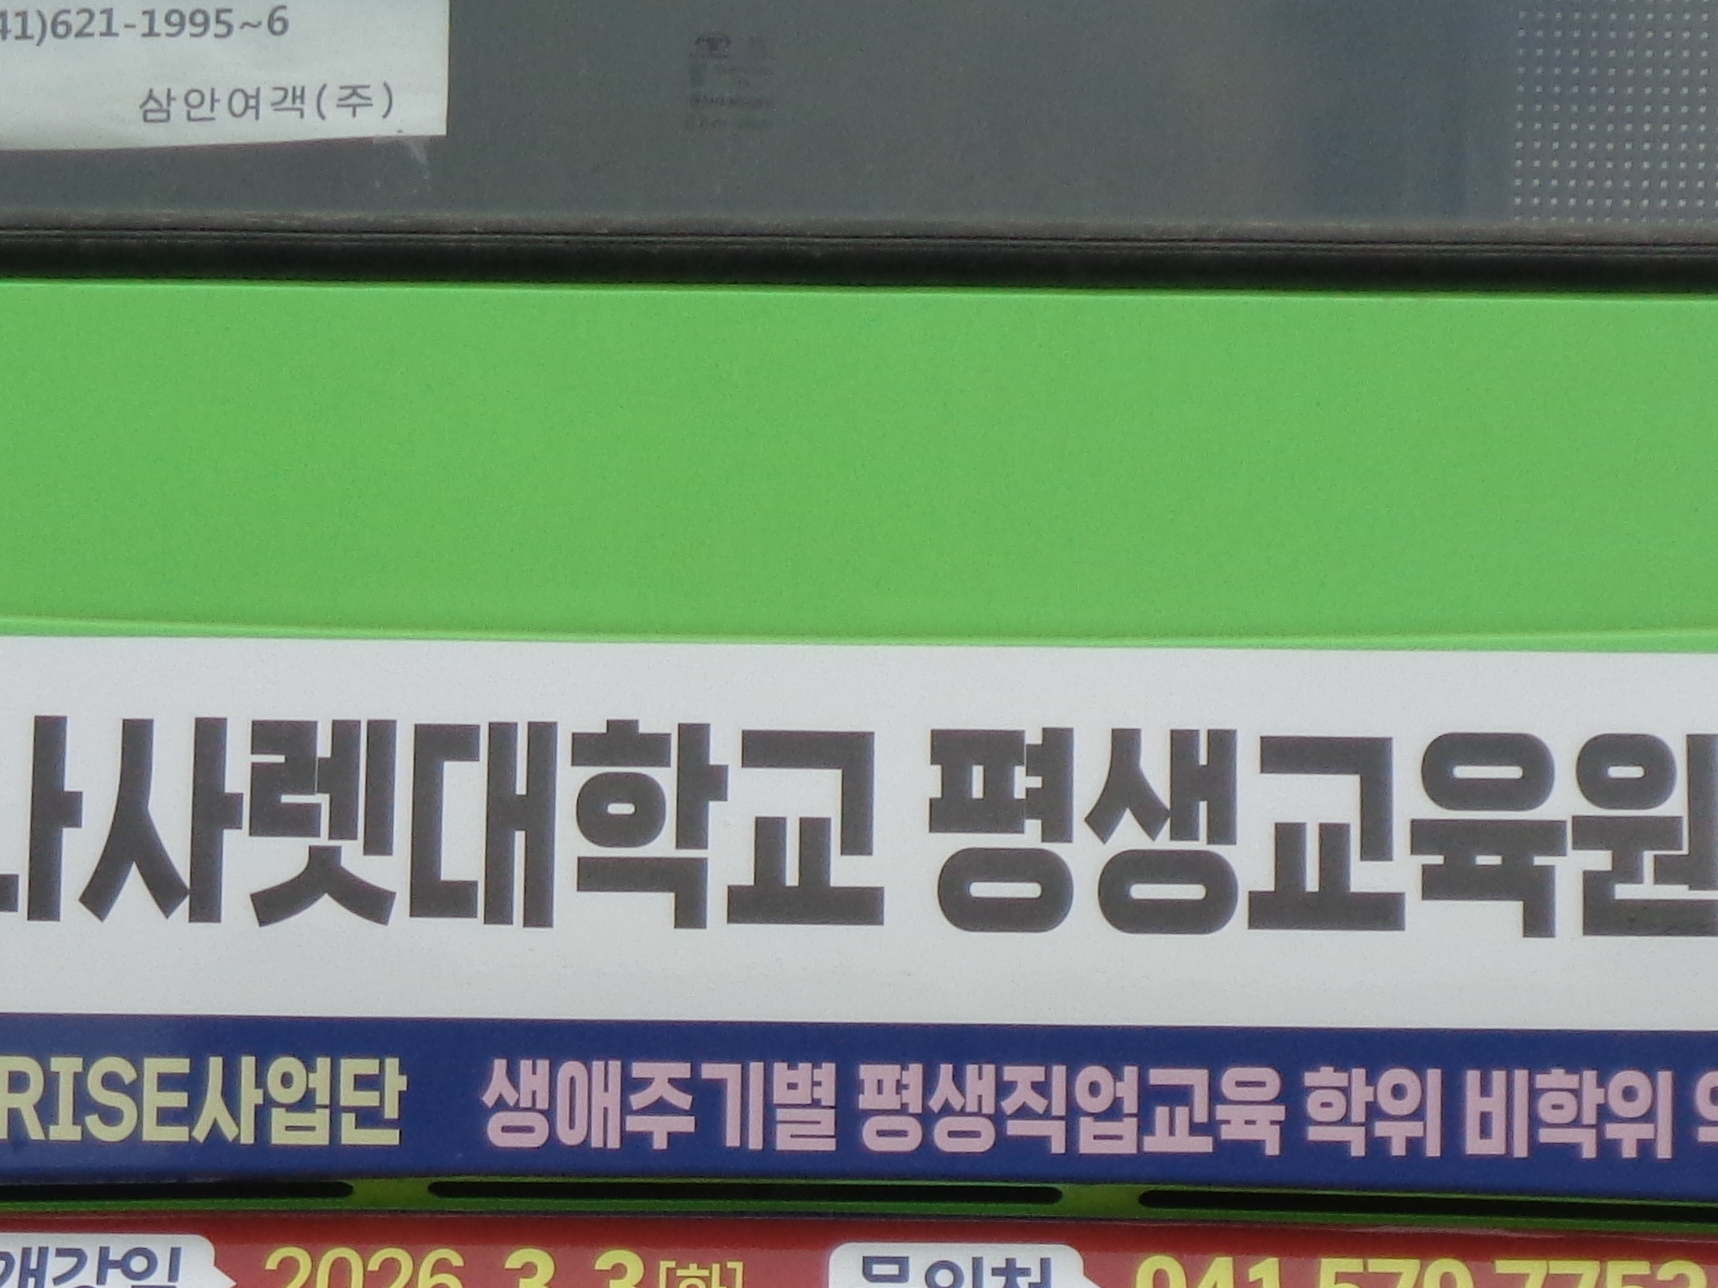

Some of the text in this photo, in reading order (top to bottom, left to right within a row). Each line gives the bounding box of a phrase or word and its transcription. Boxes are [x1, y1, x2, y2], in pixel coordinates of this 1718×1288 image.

[139, 82, 393, 123] 삼안여객(주)
[482, 1057, 837, 1152] 생애주기별
[858, 1062, 1285, 1156] 평생직업교육
[1304, 1066, 1442, 1159] 학위
[1466, 1067, 1673, 1161] 비학위
